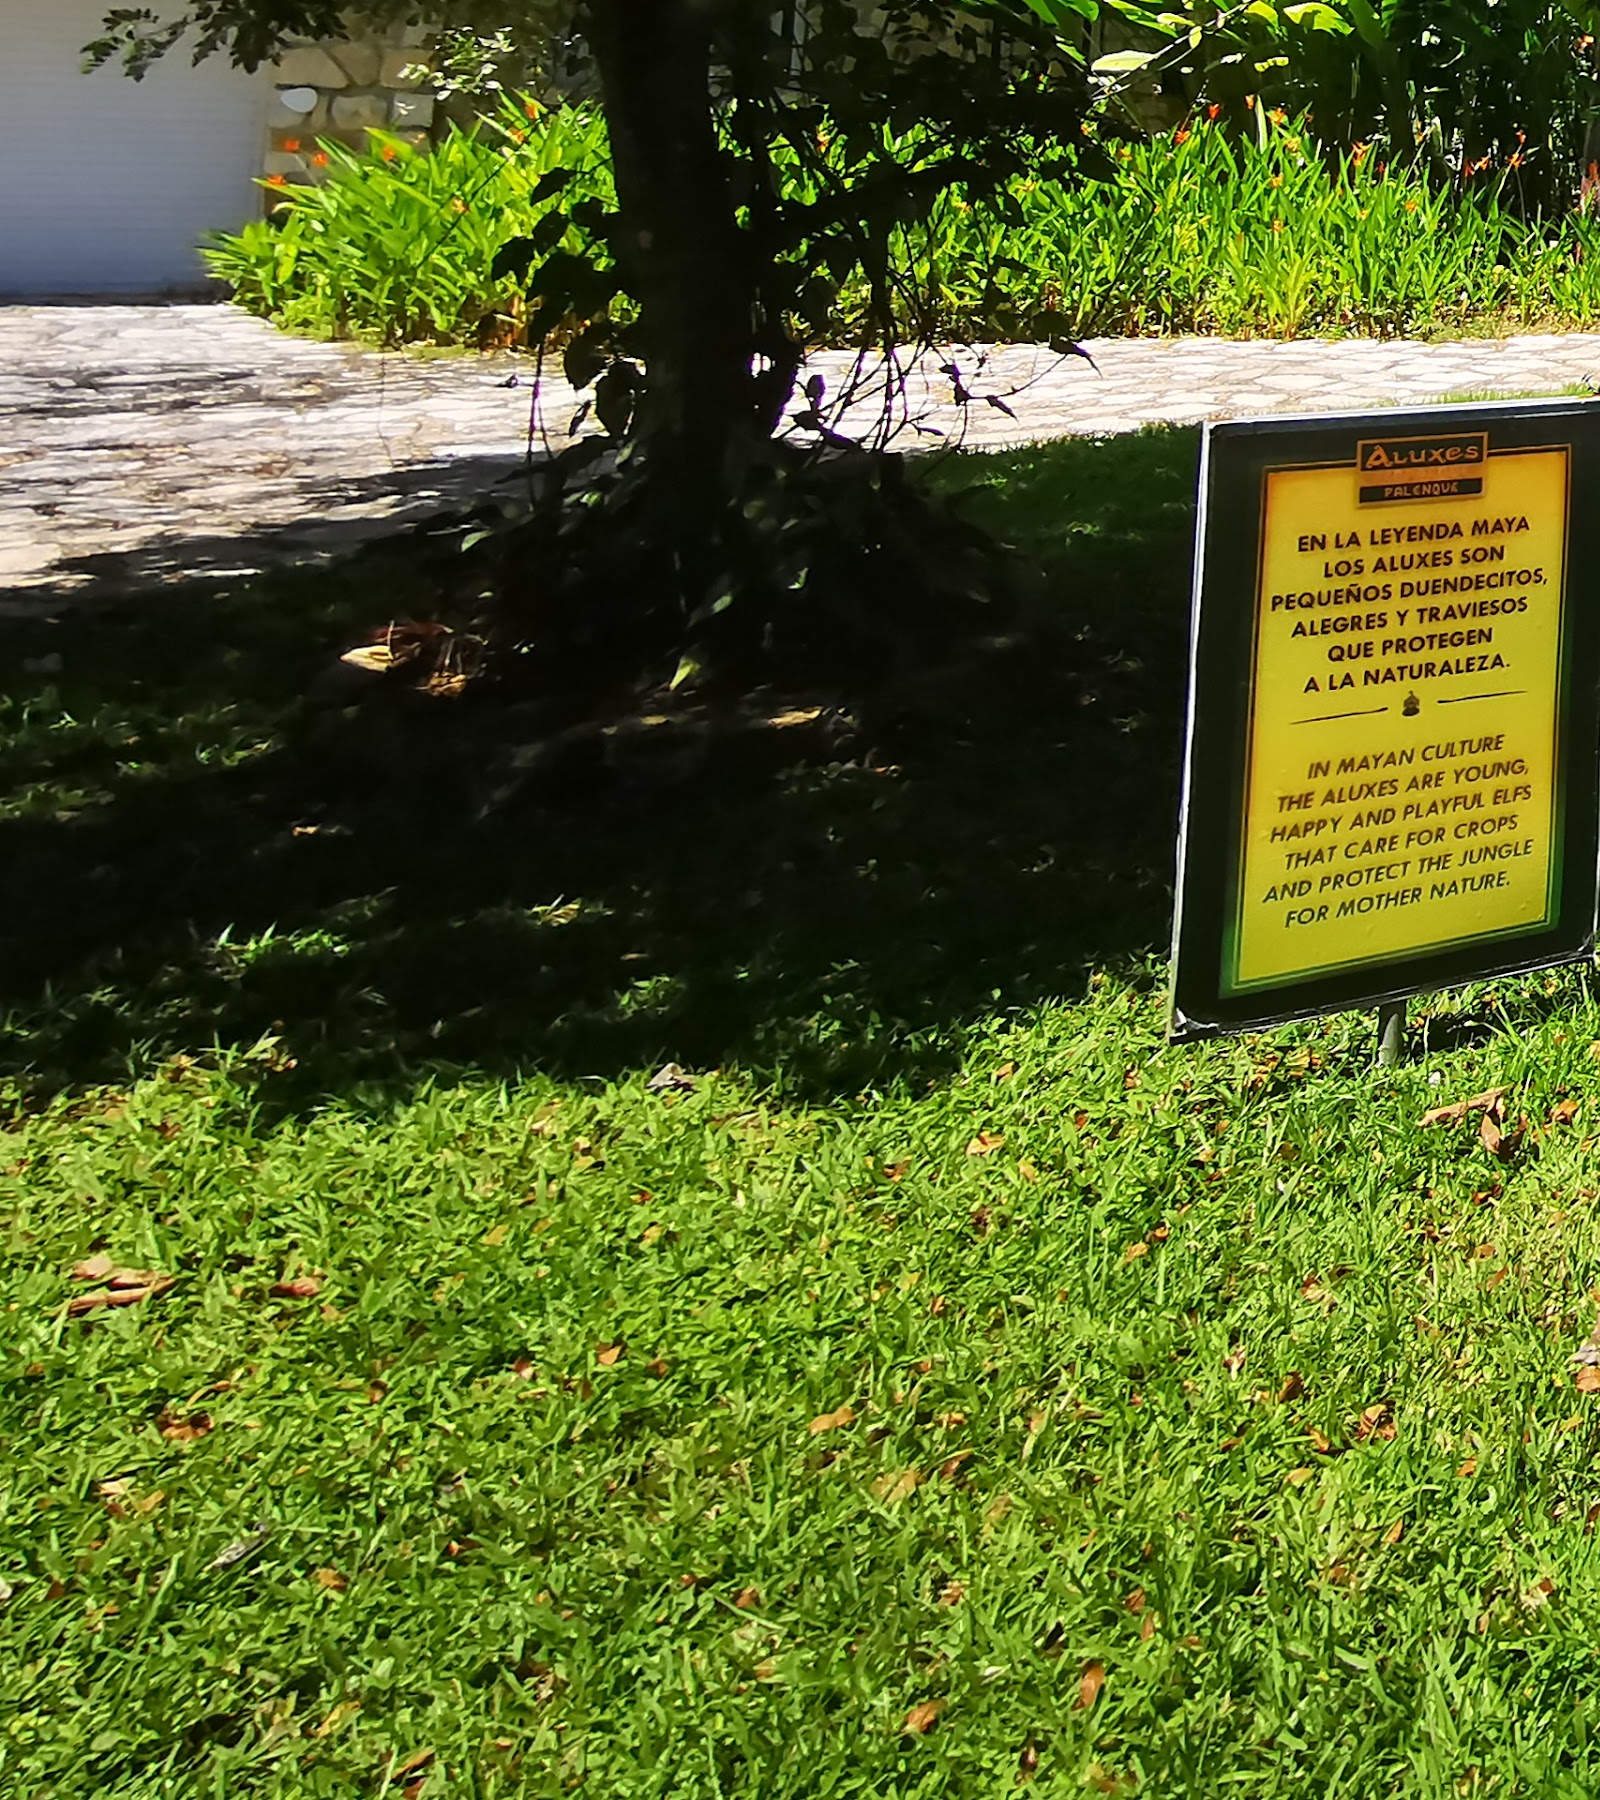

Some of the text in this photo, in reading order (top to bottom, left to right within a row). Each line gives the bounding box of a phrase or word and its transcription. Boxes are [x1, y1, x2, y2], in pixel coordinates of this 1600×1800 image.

[1385, 482, 1458, 498] PALENQUE
[1298, 517, 1529, 552] EN LA LEYENDA MAYA
[1324, 545, 1505, 578] LOS ALUXES SON
[1271, 568, 1547, 611] PEQUEÑOS DUENDECITOS,
[1291, 597, 1528, 638] ALEGRES Y TRAVIESOS
[1328, 628, 1493, 662] QUE PROTEGEN
[1303, 654, 1510, 693] A LA NATURALEZA.
[1308, 735, 1505, 779] IN MAYAN CULTURE
[1278, 759, 1529, 813] THE ALUXES ARE YOUNG,
[1270, 785, 1531, 843] HAPPY AND PLAYFUL ELFS
[1286, 815, 1518, 870] THAT CARE FOR CROPS
[1263, 839, 1533, 903] AND PROTECT THE JUNGLE
[1285, 871, 1510, 928] FOR MOTHER NATURE.
